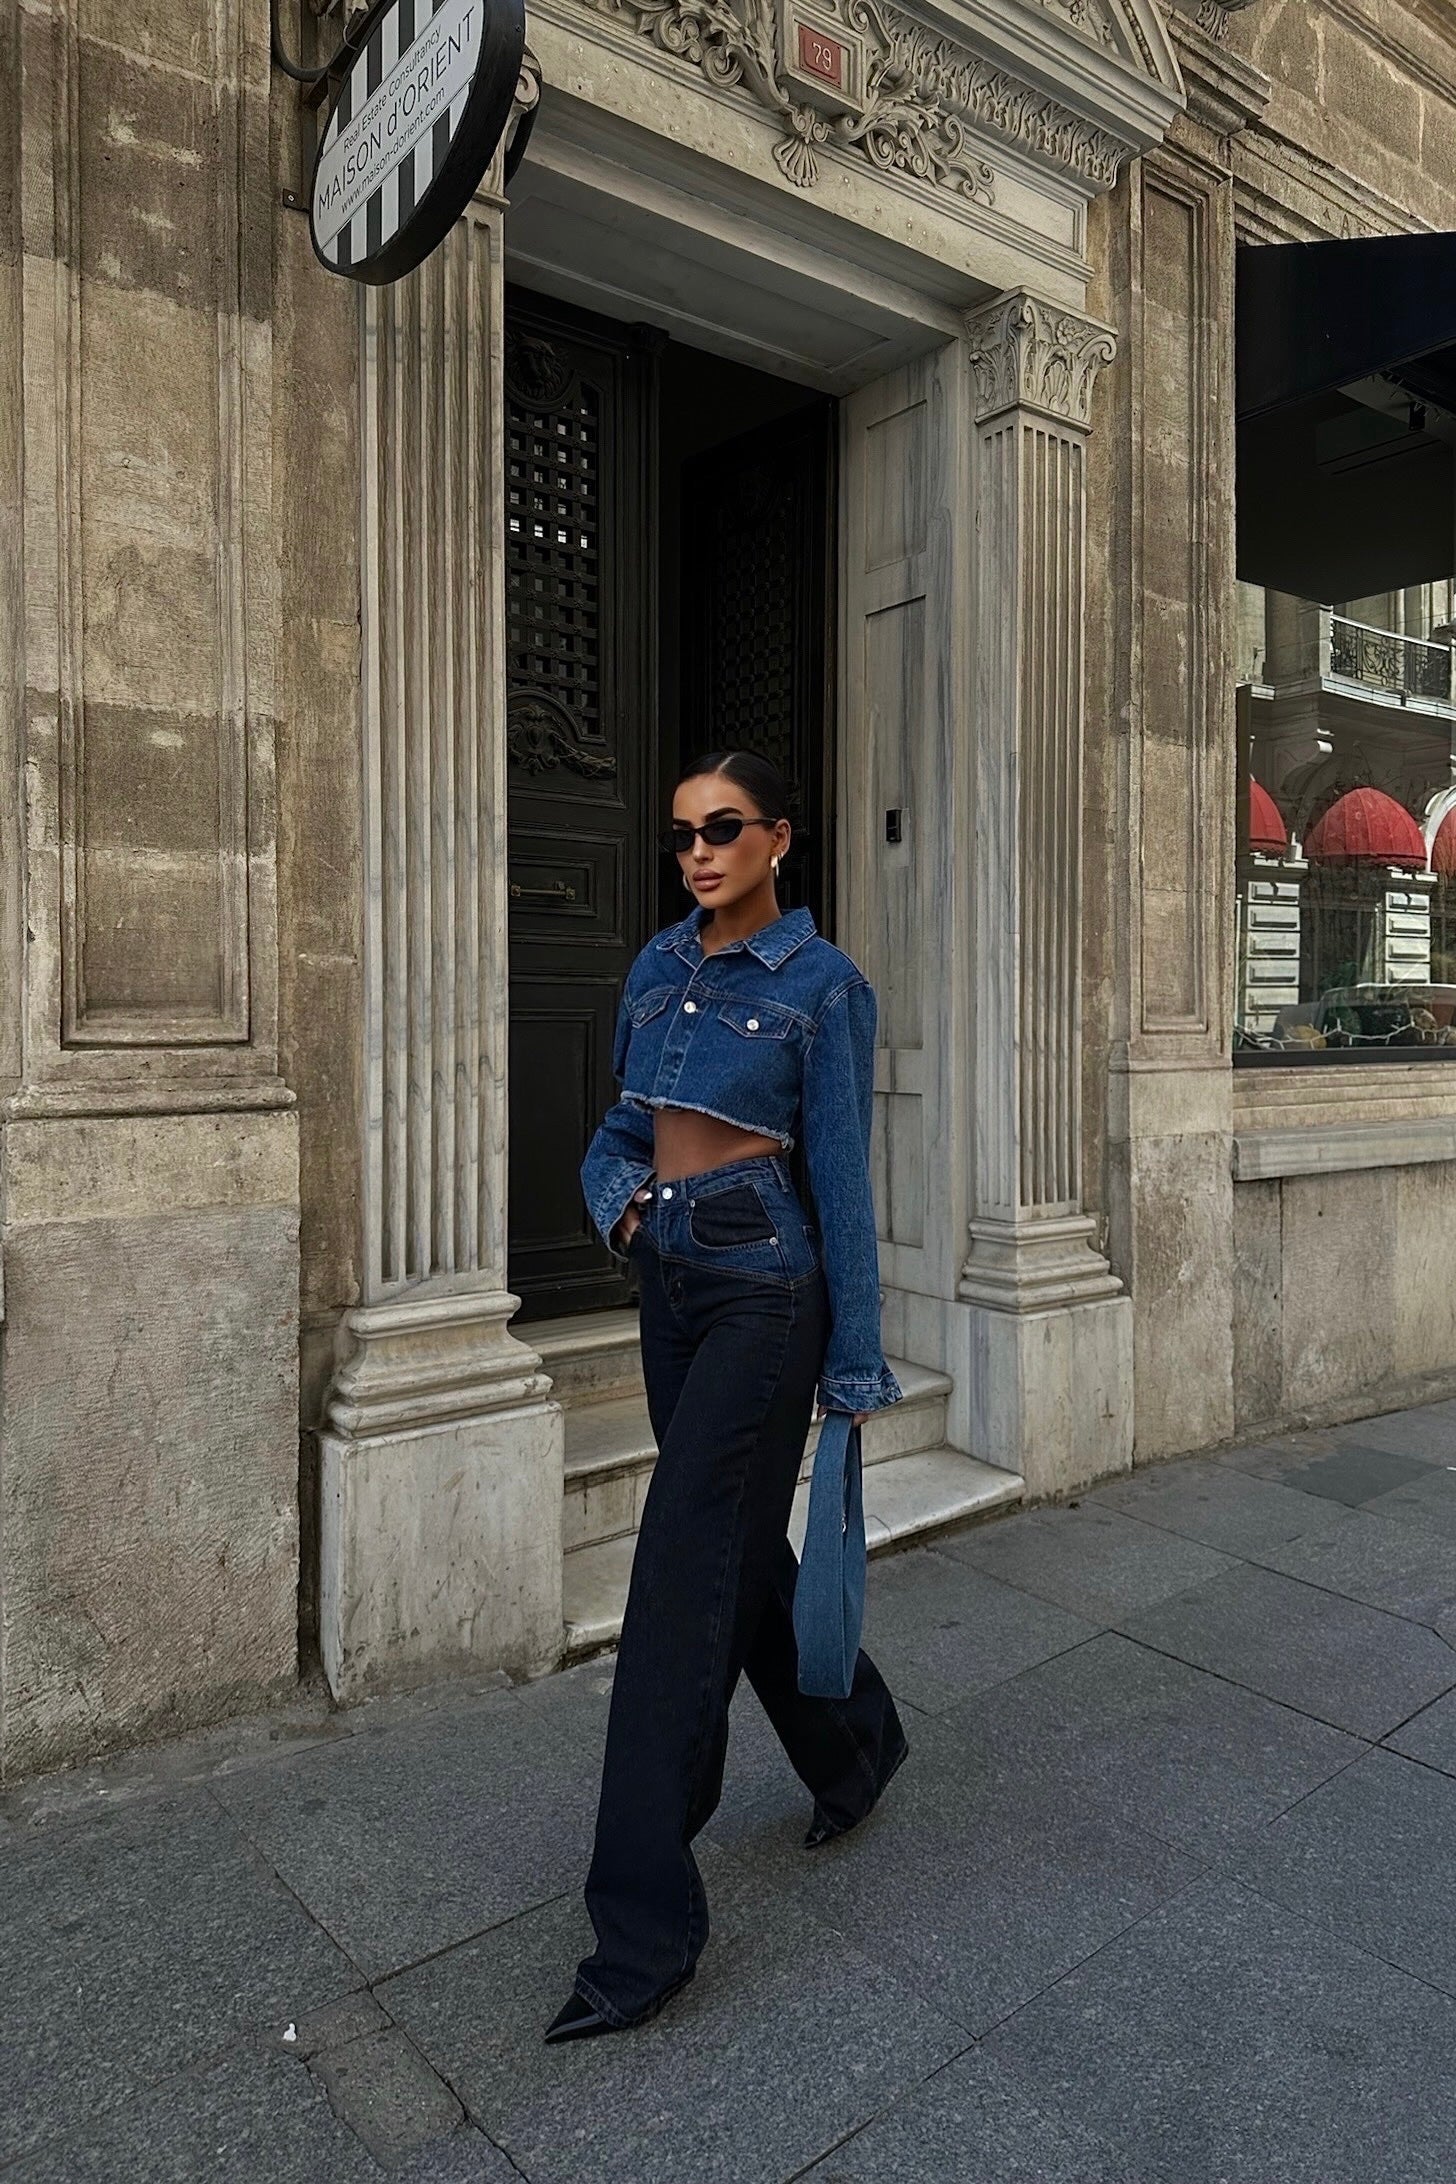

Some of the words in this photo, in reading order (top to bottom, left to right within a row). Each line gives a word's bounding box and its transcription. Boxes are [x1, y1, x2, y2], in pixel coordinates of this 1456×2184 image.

[318, 122, 382, 220] MAISON
[387, 5, 475, 136] d'ORIENT
[343, 122, 360, 153] Real
[362, 94, 387, 131] Estate
[388, 24, 442, 97] Consultancy
[812, 41, 832, 71] 79
[341, 87, 445, 213] www.maison-dorient.com
